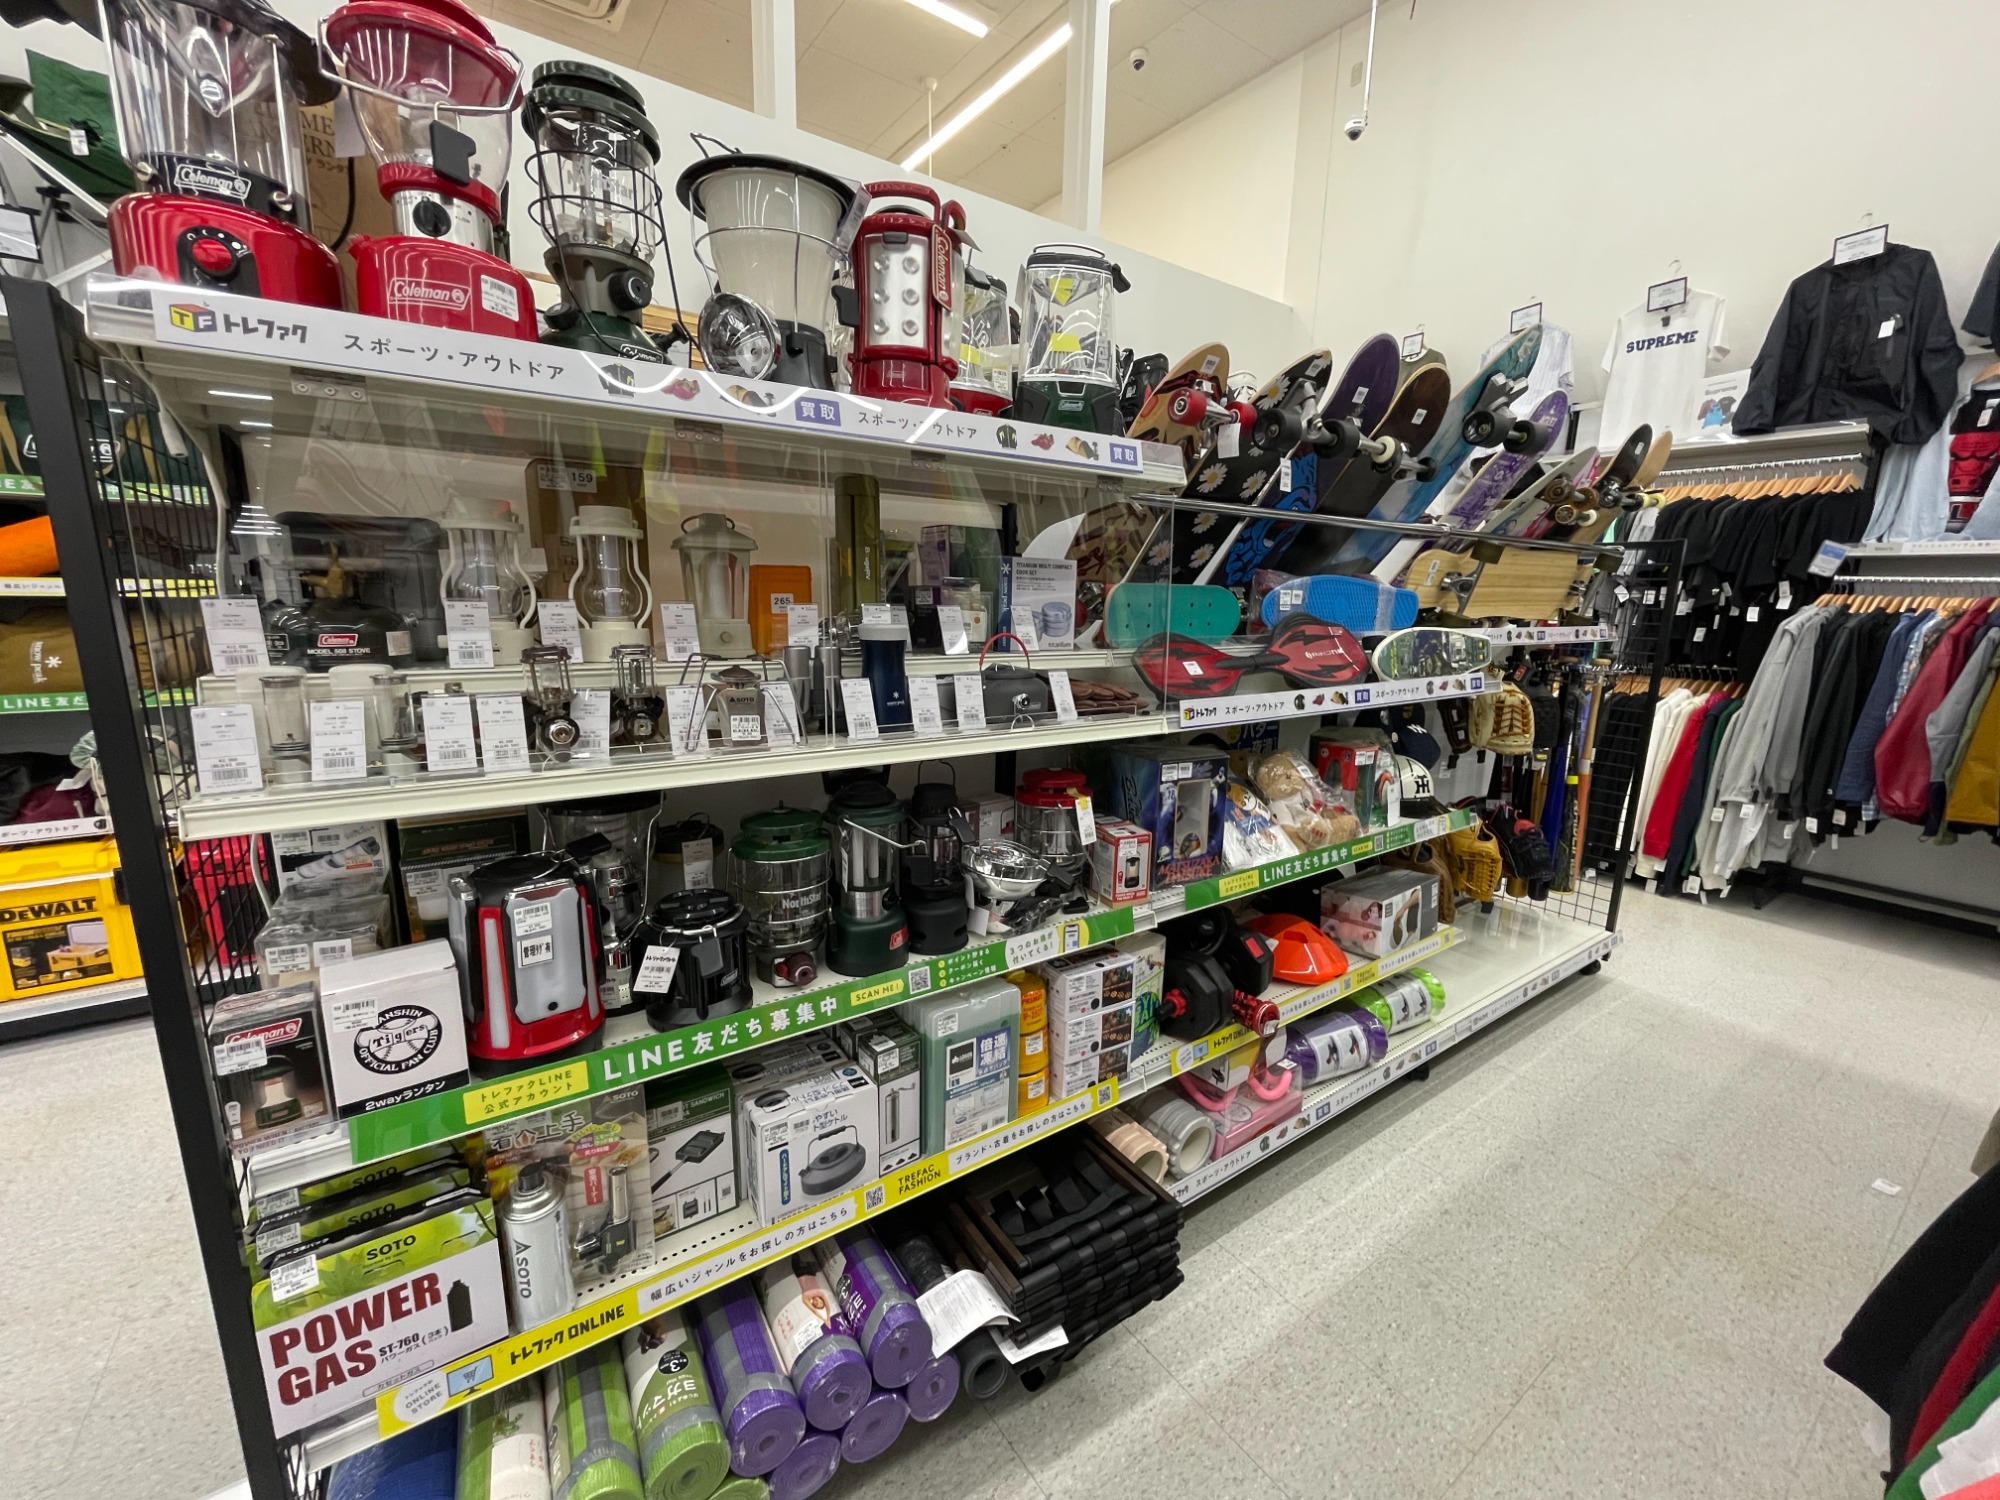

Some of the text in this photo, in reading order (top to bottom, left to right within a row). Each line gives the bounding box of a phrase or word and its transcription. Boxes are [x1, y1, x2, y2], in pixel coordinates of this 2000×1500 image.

[181, 165, 233, 191] Coleman
[936, 236, 949, 295] Coleman
[393, 279, 450, 302] Coleman
[223, 313, 308, 343] トレファク
[344, 333, 564, 380] スポーツ・アウトドア
[1625, 329, 1699, 354] SUPREME
[799, 400, 977, 438] 買取 スポーツ・ウトドア
[1112, 447, 1135, 463] 買取
[571, 472, 593, 483] 159
[774, 597, 791, 606] 265
[855, 988, 880, 1002] SCAN
[377, 1008, 423, 1025] ANSHIN
[372, 1023, 425, 1048] Tigers
[359, 1029, 440, 1072] OFFICIAL FAN CLUB
[365, 1080, 446, 1111] 2wayランタン
[484, 1082, 573, 1114] 公式アカウント
[612, 1090, 639, 1101] SOTO
[690, 1092, 725, 1108] SANDWICH
[956, 1100, 1086, 1165] ブランド・古着をお探しの方はこちら
[352, 1166, 397, 1188] SOTO
[897, 1163, 935, 1186] TREFAC
[898, 1171, 942, 1196] FASHION
[347, 1202, 396, 1227] SOTO
[366, 1235, 417, 1261] SOTO
[510, 1207, 850, 1366] トレファク ONLINE 幅広いジャンルをお探しの方はこちら
[517, 1256, 532, 1299] SOTO
[269, 1272, 441, 1369] POWER
[379, 1332, 420, 1357] ST-760
[380, 1343, 421, 1364] パワーガス
[277, 1339, 377, 1406] GAS
[376, 1367, 421, 1391] カセットガス
[405, 1382, 441, 1409] ONLINE
[411, 1391, 442, 1415] STORE
[637, 1378, 697, 1430] ヨガマット
